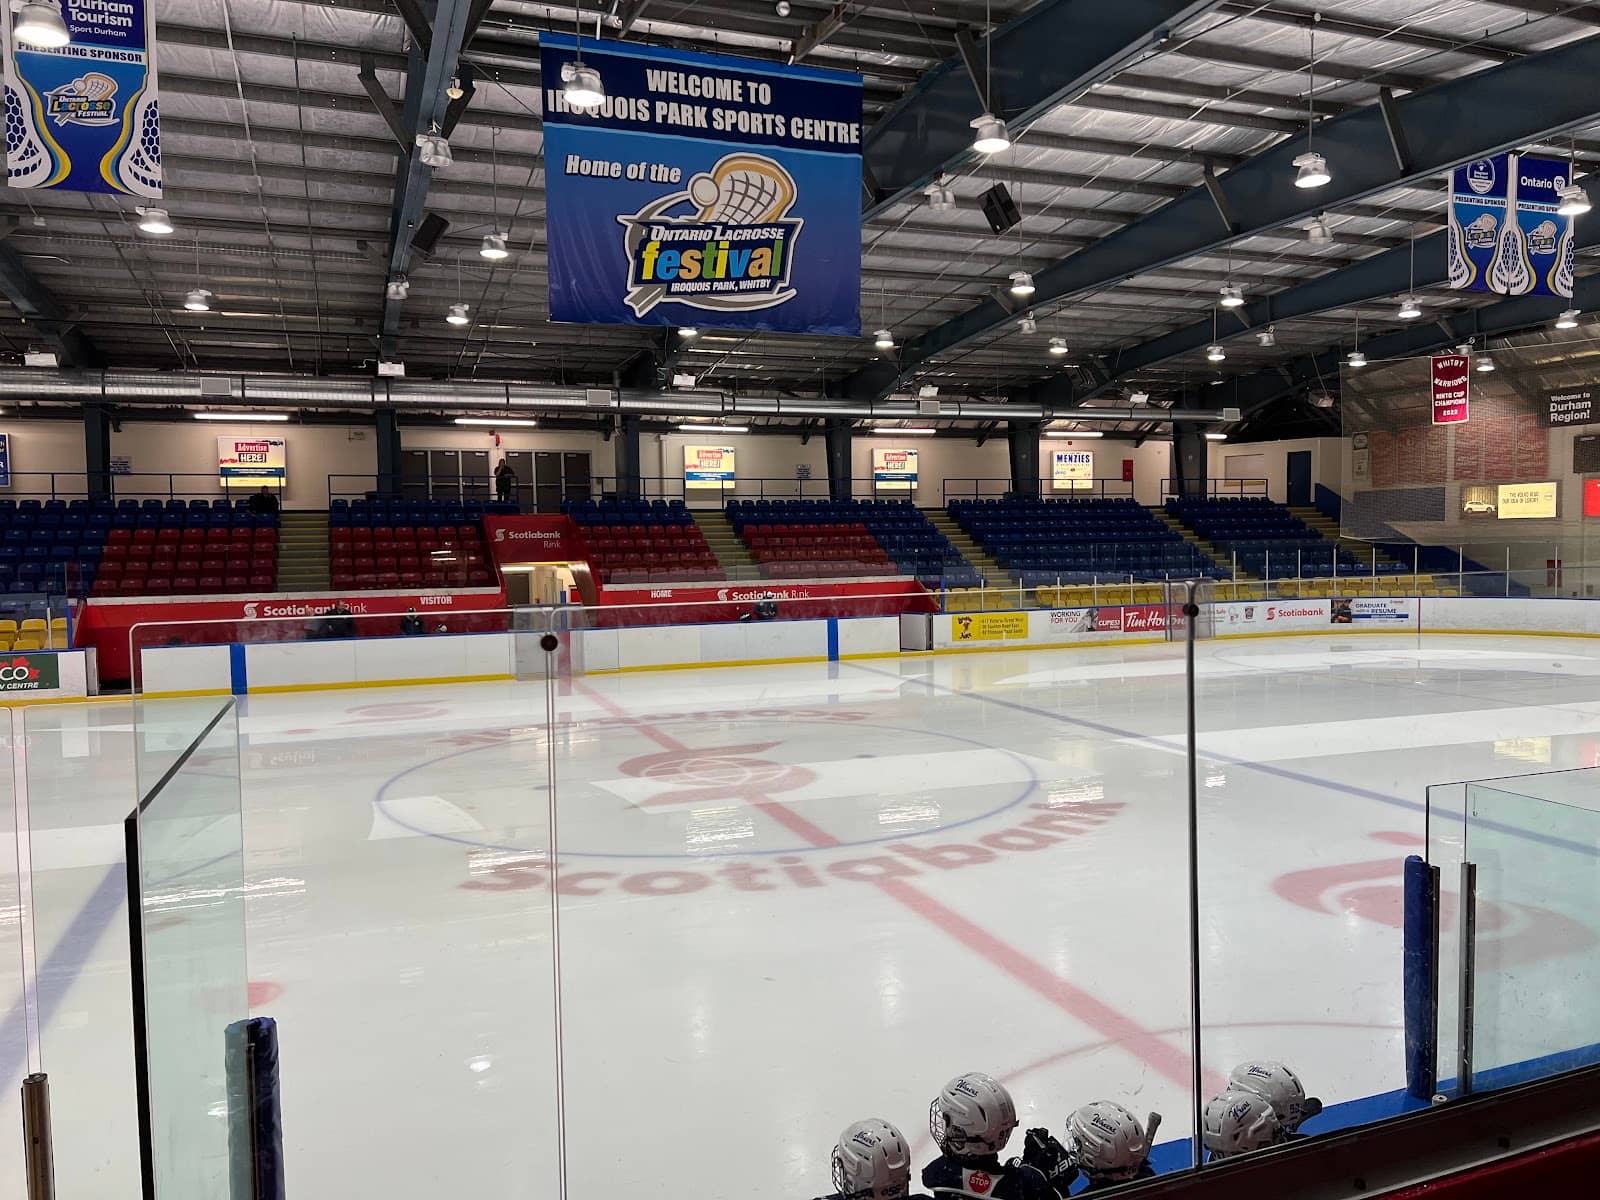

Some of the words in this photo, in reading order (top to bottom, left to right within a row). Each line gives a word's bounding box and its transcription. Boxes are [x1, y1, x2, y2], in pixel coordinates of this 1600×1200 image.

[68, 0, 134, 14] Durham
[68, 8, 132, 27] Tourism
[70, 24, 92, 34] Sport
[94, 27, 126, 37] Durham
[90, 49, 142, 62] SPONSOR
[646, 68, 743, 102] WELCOME
[747, 82, 771, 105] TO
[53, 100, 111, 112] Lacrosse
[656, 102, 708, 128] PARK
[712, 108, 786, 137] SPORTS
[791, 118, 860, 144] CENTRE
[566, 154, 621, 177] Home
[626, 162, 647, 180] of
[650, 162, 682, 183] the
[1520, 176, 1552, 189] Ontario
[651, 225, 712, 241] ONTARIO
[714, 225, 785, 241] LACROSSE
[642, 240, 784, 280] festival
[671, 282, 710, 292] IROQUOIS
[712, 280, 738, 292] PARK,
[739, 279, 772, 290] WHITBY
[1550, 401, 1592, 412] Durham
[1550, 410, 1590, 423] Region!
[240, 453, 266, 462] HERE!
[1056, 454, 1090, 462] MENZIES
[508, 530, 560, 539] Scotiabank
[543, 540, 560, 549] Rink
[650, 590, 672, 598] HOME
[420, 596, 452, 606] VISITOR
[1278, 608, 1324, 617] Scotiabank
[1126, 612, 1146, 628] Tim
[7, 682, 39, 690] CENTRE
[457, 801, 1128, 897] Scotiabank
[970, 1176, 989, 1187] STOP
